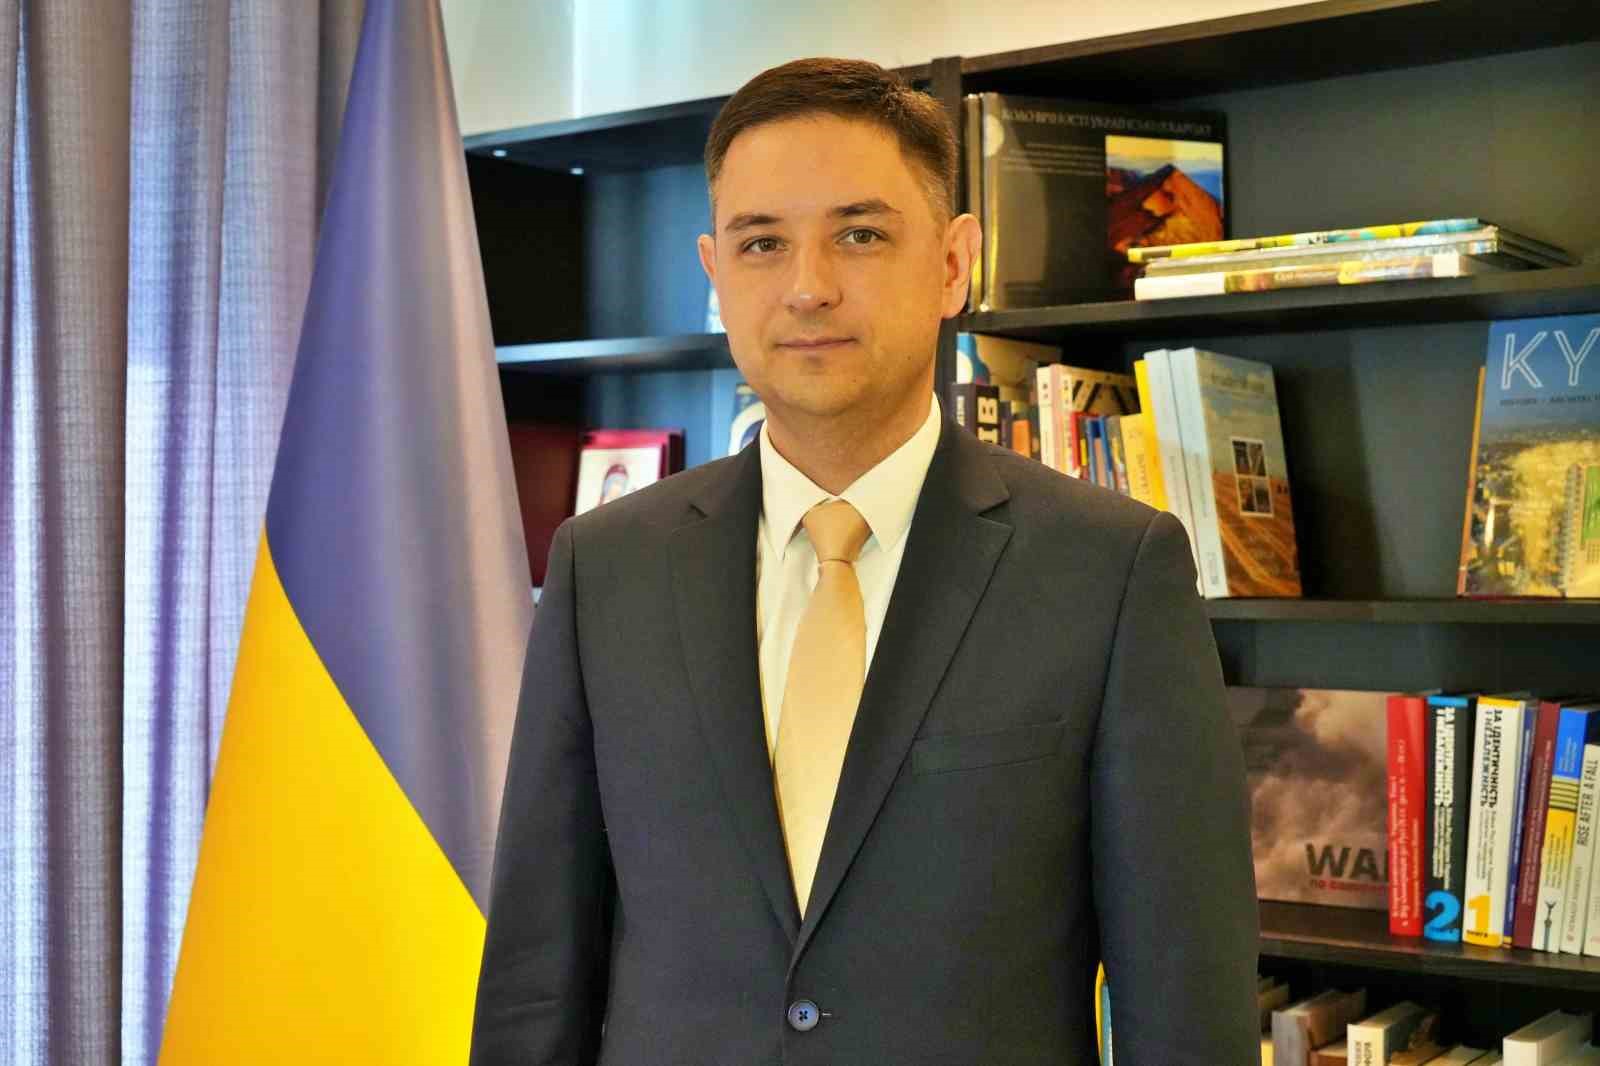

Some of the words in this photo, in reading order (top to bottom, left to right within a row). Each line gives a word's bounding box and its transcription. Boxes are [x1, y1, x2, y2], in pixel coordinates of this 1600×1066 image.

[1584, 759, 1598, 782] FALL
[1579, 793, 1594, 823] AFTER
[1576, 824, 1590, 847] RISE
[1425, 890, 1461, 943] 2
[1467, 894, 1492, 939] 1
